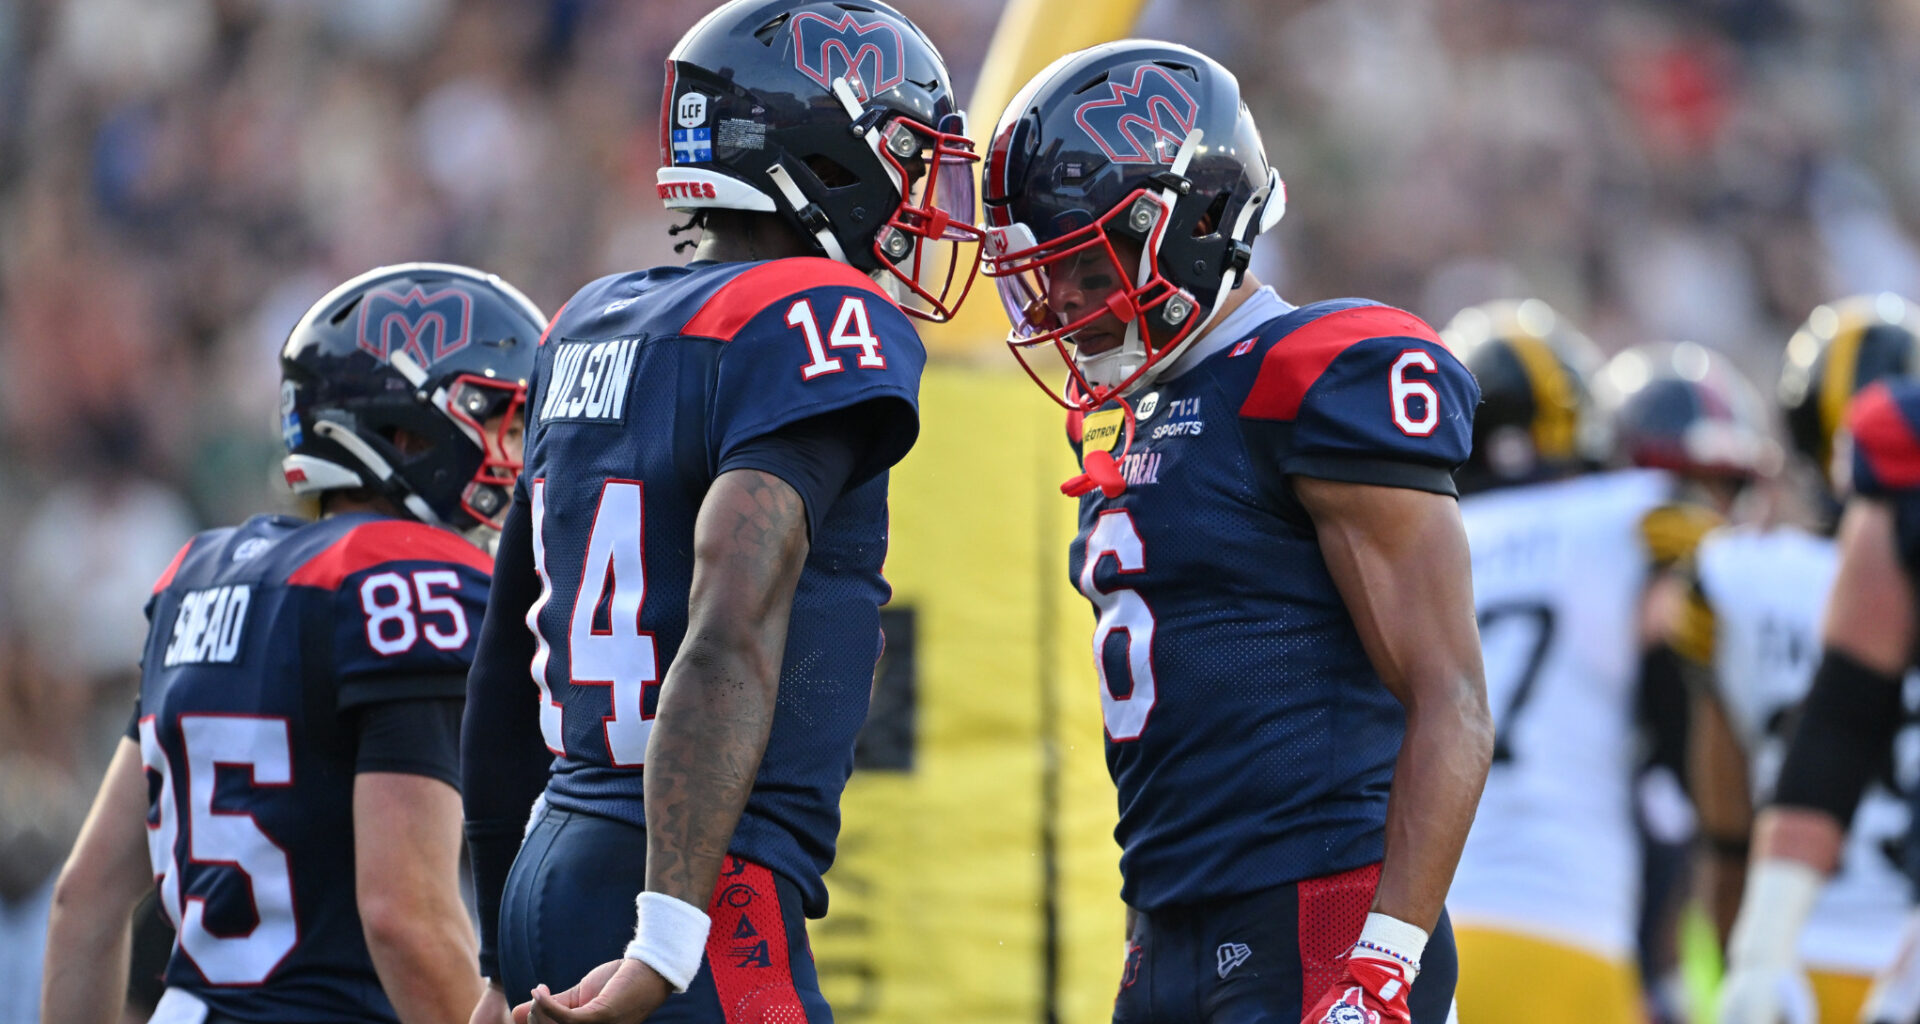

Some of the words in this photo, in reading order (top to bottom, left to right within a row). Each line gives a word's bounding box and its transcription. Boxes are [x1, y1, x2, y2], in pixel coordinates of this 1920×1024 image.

[681, 104, 701, 118] LCF
[656, 182, 716, 199] ETTES
[784, 295, 887, 381] 14
[540, 339, 640, 420] WILSON
[1388, 348, 1440, 437] 6
[1114, 447, 1162, 485] TRÉAL
[1152, 420, 1203, 439] SPORTS
[358, 570, 470, 656] 85
[1080, 508, 1158, 743] 6
